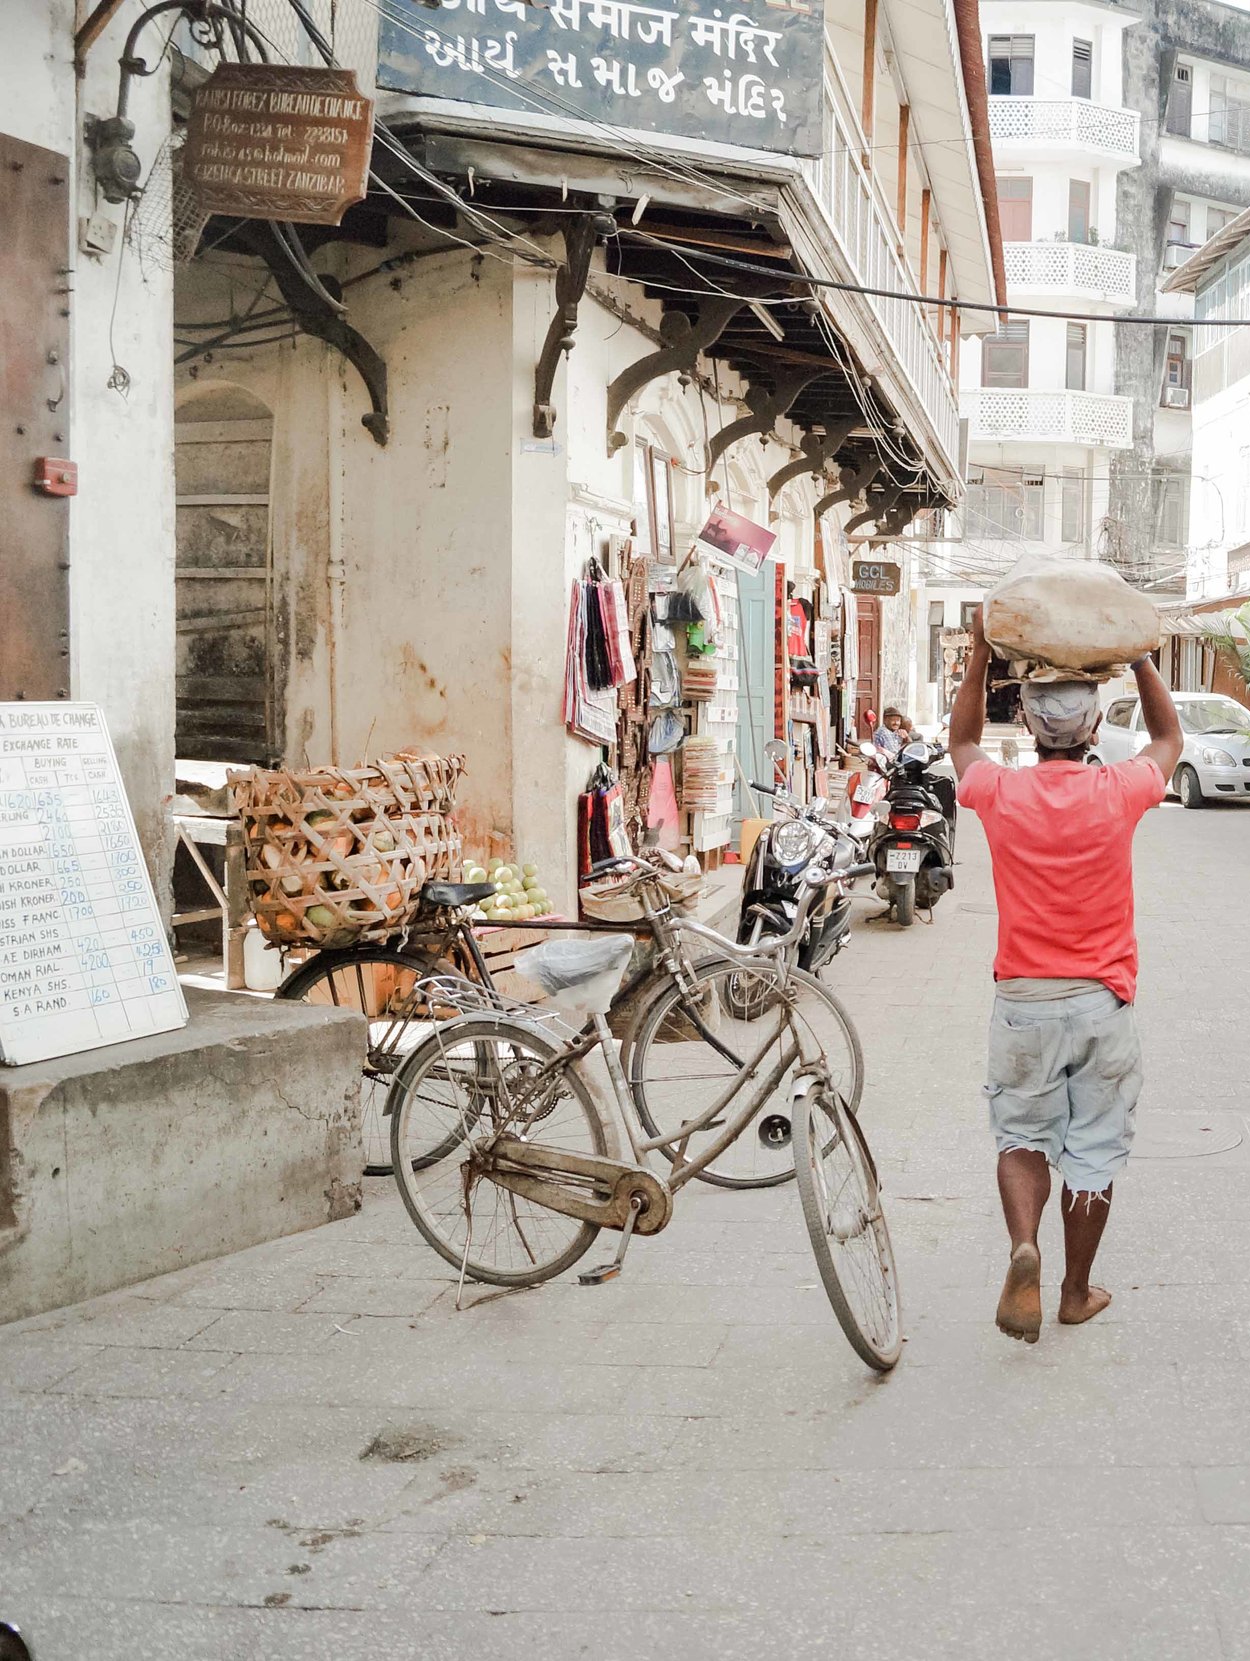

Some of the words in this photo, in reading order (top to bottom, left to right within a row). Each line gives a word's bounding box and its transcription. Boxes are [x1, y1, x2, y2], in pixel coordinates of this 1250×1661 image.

[859, 565, 890, 580] GCL
[8, 713, 49, 729] BUREAU
[63, 712, 98, 729] CHANGE
[3, 738, 52, 752] EXCHANGE
[57, 737, 79, 750] RATE
[34, 757, 67, 769] BUYING
[61, 890, 85, 907] 200
[1, 968, 32, 984] OMAN
[4, 983, 42, 1001] KENYA
